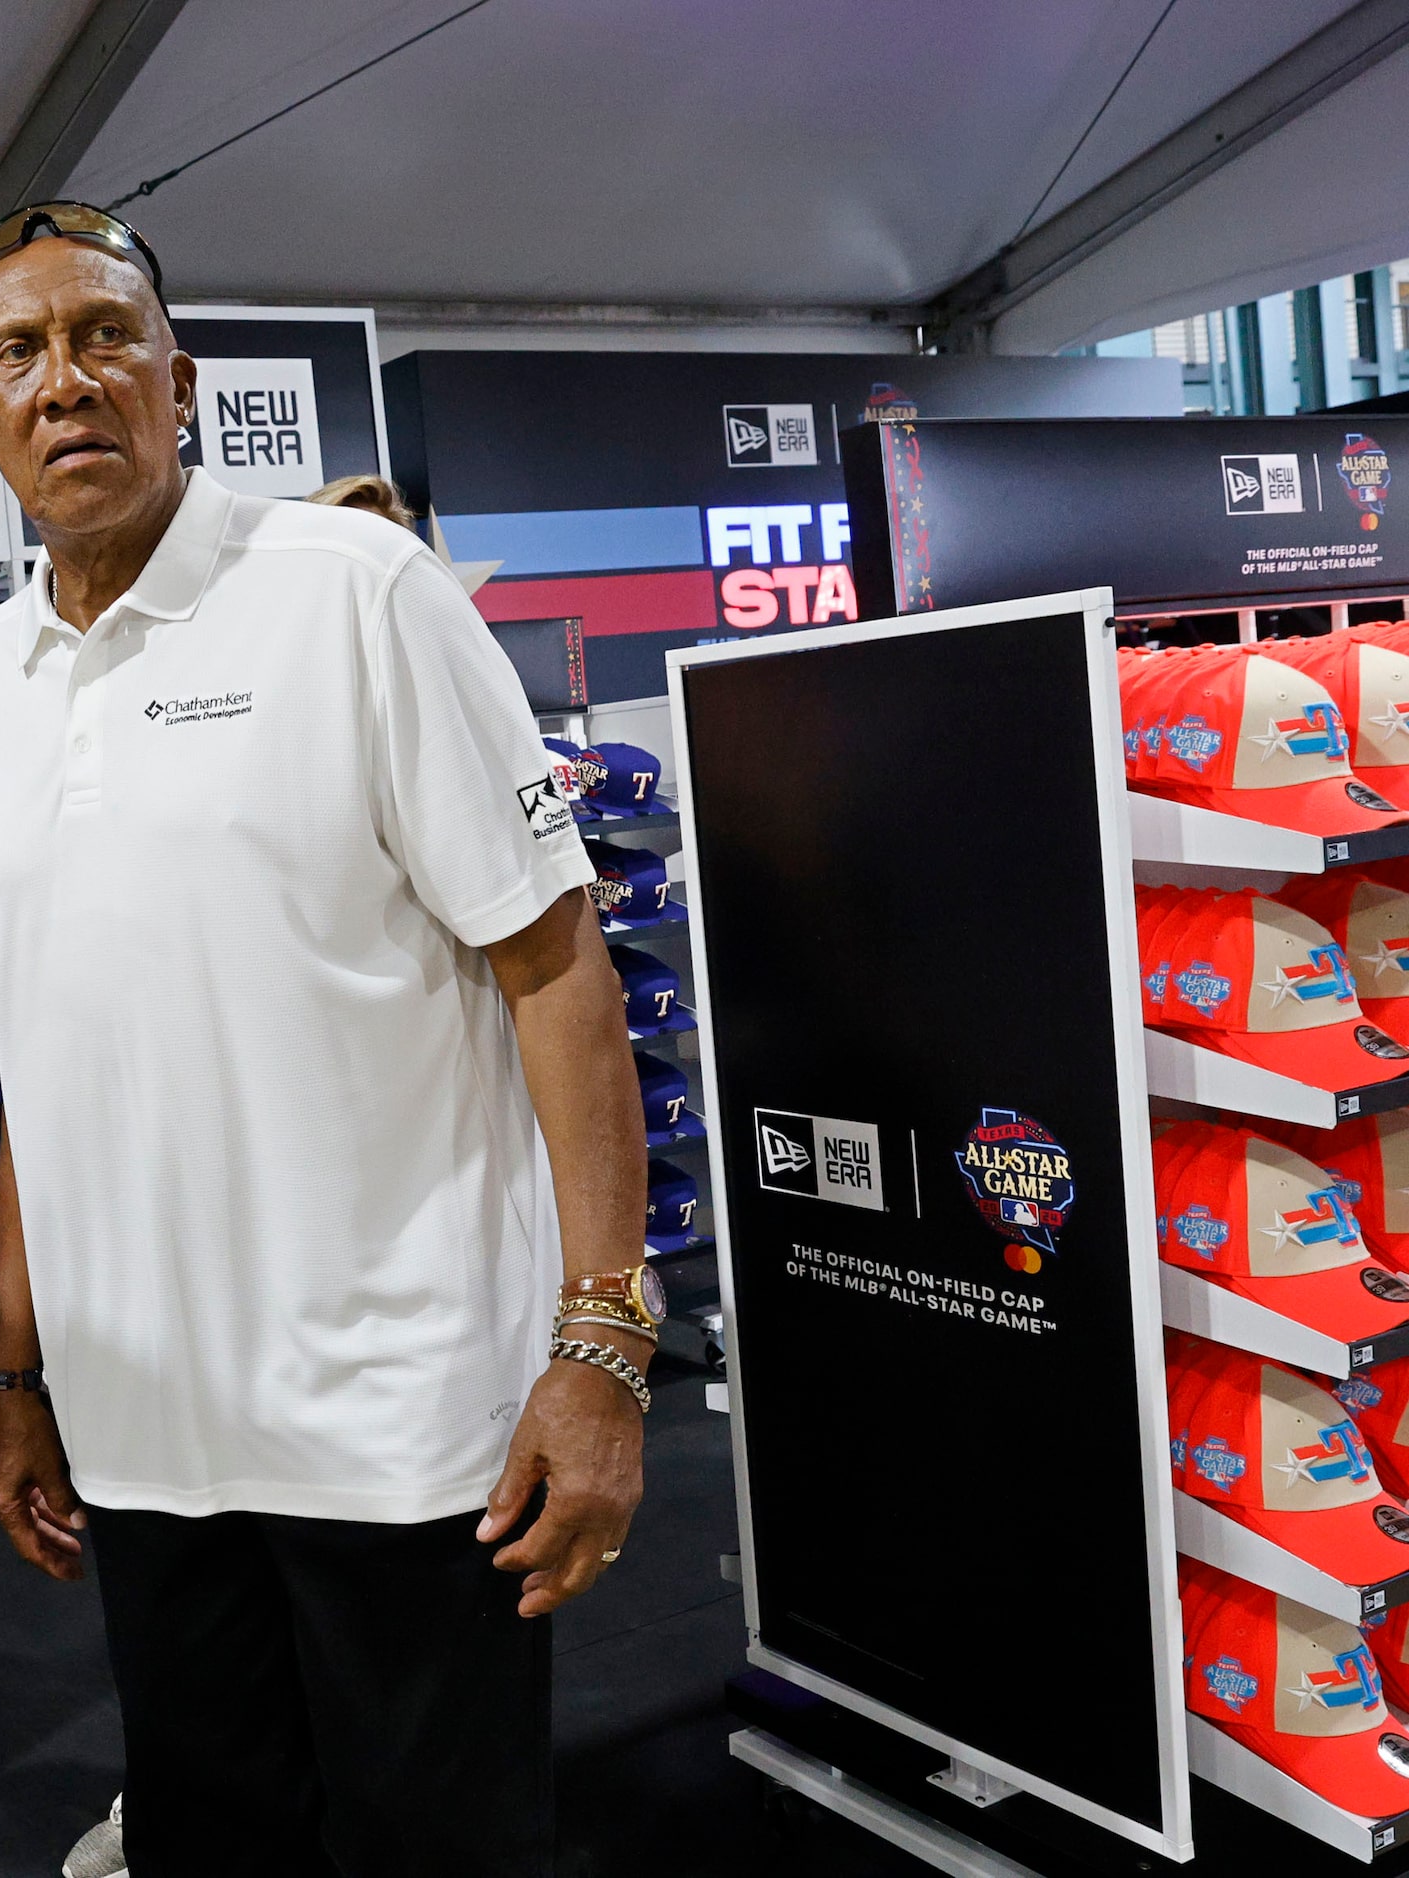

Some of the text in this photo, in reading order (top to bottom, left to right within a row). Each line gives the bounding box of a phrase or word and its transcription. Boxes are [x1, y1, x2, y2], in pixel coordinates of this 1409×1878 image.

[216, 390, 298, 428] NEW
[776, 418, 807, 435] NEW
[221, 429, 303, 467] ERA
[778, 435, 809, 452] ERA
[1267, 467, 1294, 483] NEW
[1350, 470, 1383, 486] GAME
[1269, 484, 1296, 500] ERA
[705, 504, 813, 567] FIT
[1242, 563, 1256, 575] OF
[1256, 562, 1276, 574] THE
[1301, 557, 1347, 571] ALL-STAR
[1246, 543, 1379, 561] THE OFFICIAL ON-FIELD CAP
[722, 564, 858, 629] STA
[165, 691, 253, 715] Chatham-Kent
[165, 705, 253, 726] Economic Development
[1176, 736, 1209, 752] GAME
[1302, 701, 1345, 762] T
[553, 764, 574, 792] T
[633, 772, 653, 800] T
[589, 883, 621, 904] GAME
[655, 881, 671, 909] T
[1308, 943, 1350, 1004] T
[655, 989, 674, 1018] T
[1186, 984, 1219, 998] GAME
[666, 1096, 685, 1123] T
[982, 1126, 1021, 1139] TEXAS
[824, 1135, 870, 1166] NEW
[826, 1161, 872, 1190] ERA
[983, 1169, 1053, 1202] GAME
[680, 1198, 696, 1227] T
[1305, 1186, 1359, 1248] T
[1184, 1228, 1217, 1241] GAME
[792, 1243, 1045, 1312] THE OFFICIAL ON-FIELD CAP
[786, 1261, 808, 1276] OF
[810, 1266, 841, 1287] THE
[890, 1285, 976, 1320] ALL-STAR
[980, 1306, 1057, 1335] GAME™
[1318, 1420, 1365, 1485] T
[1201, 1460, 1234, 1475] GAME
[1213, 1677, 1245, 1695] GAME
[1333, 1644, 1380, 1712] T
